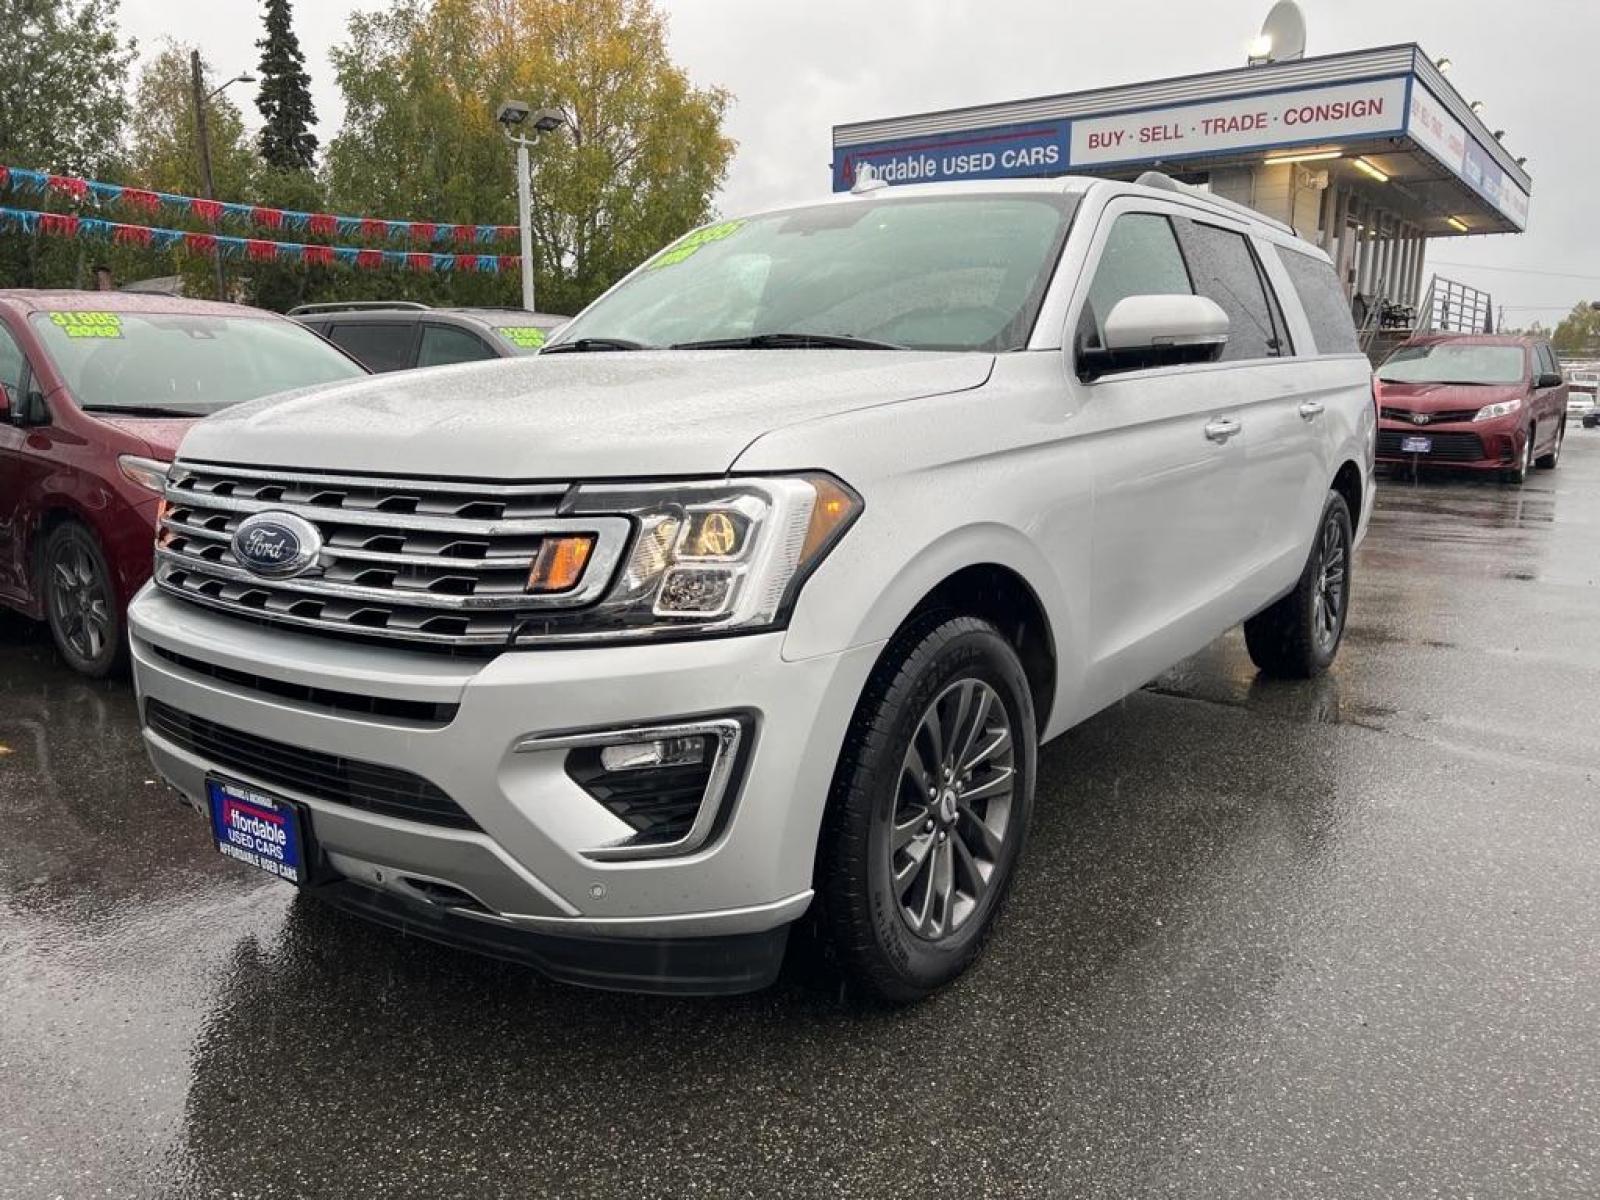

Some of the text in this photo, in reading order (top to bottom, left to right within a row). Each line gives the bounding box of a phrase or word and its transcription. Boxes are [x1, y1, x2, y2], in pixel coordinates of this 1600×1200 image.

[1088, 98, 1383, 149] BUY SELL TRADE CONSIGN
[943, 155, 996, 175] USED
[1001, 144, 1059, 167] CARS
[245, 528, 285, 559] Ford
[228, 828, 284, 860] USED CARS
